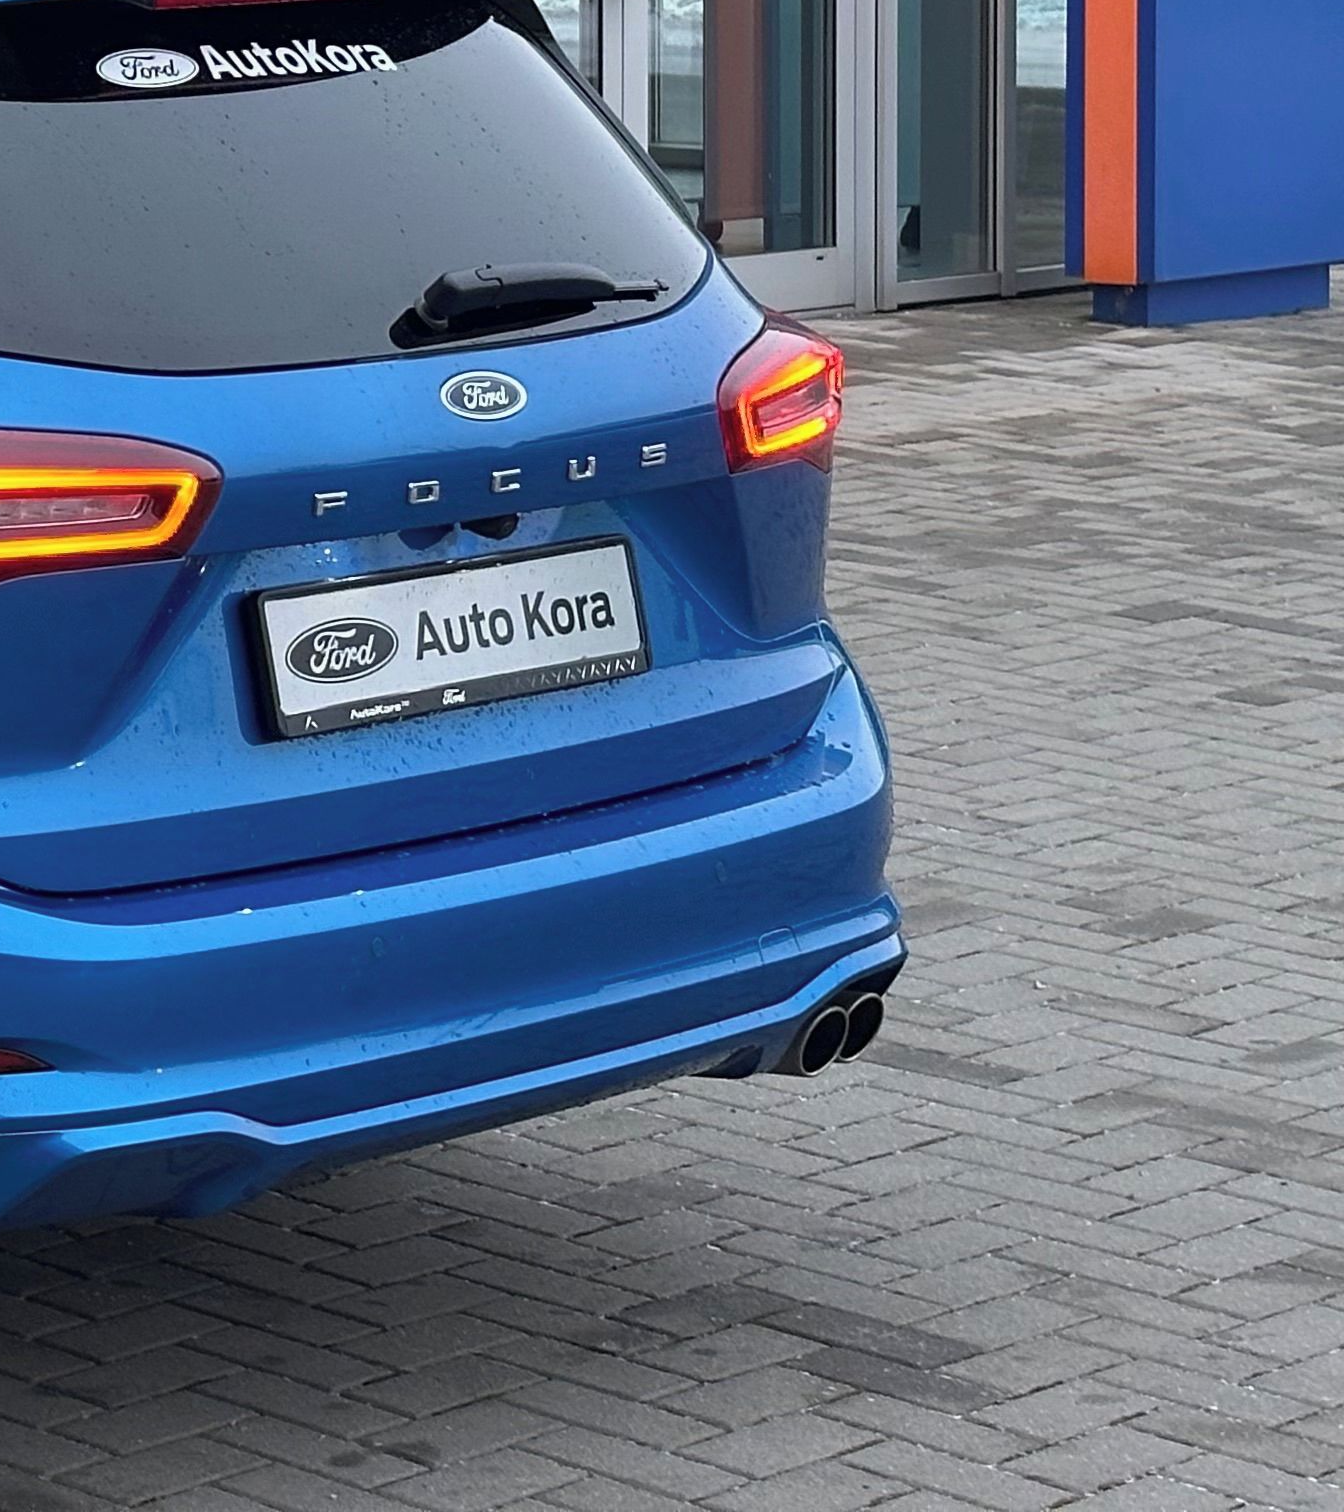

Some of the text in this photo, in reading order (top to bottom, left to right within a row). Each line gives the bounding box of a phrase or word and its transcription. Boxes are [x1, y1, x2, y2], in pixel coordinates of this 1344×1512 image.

[120, 39, 398, 80] Ford AutoKora
[462, 380, 510, 411] Ford
[314, 442, 667, 517] FOCUS
[310, 589, 615, 674] Ford Auto Kora
